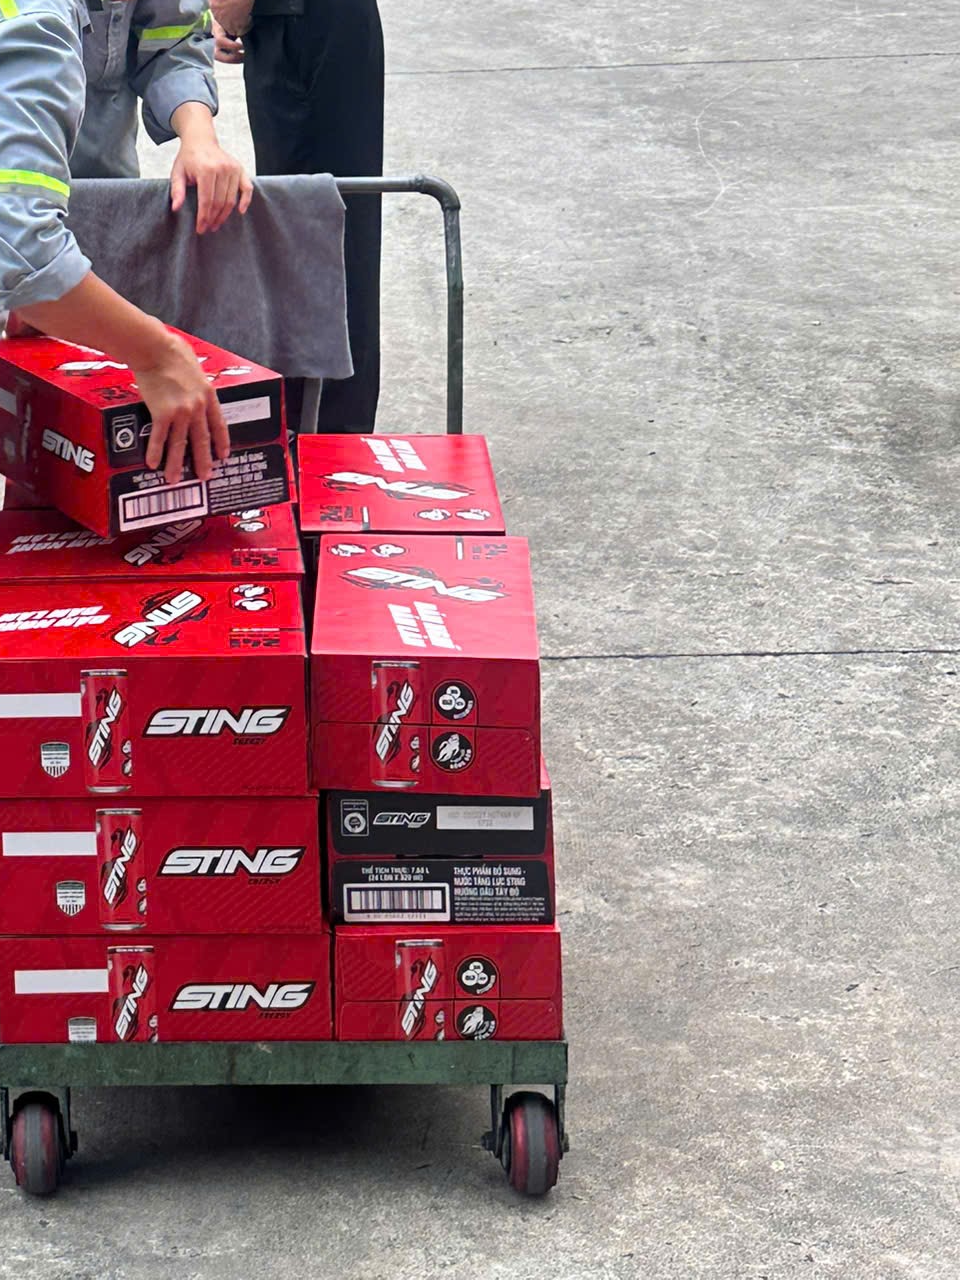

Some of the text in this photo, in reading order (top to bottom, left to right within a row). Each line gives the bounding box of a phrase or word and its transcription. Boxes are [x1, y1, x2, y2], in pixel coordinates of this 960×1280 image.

[41, 428, 95, 473] STING
[114, 590, 202, 647] STING
[88, 689, 122, 767] STING
[146, 708, 286, 735] STING
[374, 682, 414, 761] STING
[372, 811, 432, 826] STING
[103, 829, 138, 906] STING
[161, 848, 301, 874] STING
[114, 966, 148, 1042] STING
[172, 984, 311, 1010] STING
[401, 955, 438, 1039] STING
